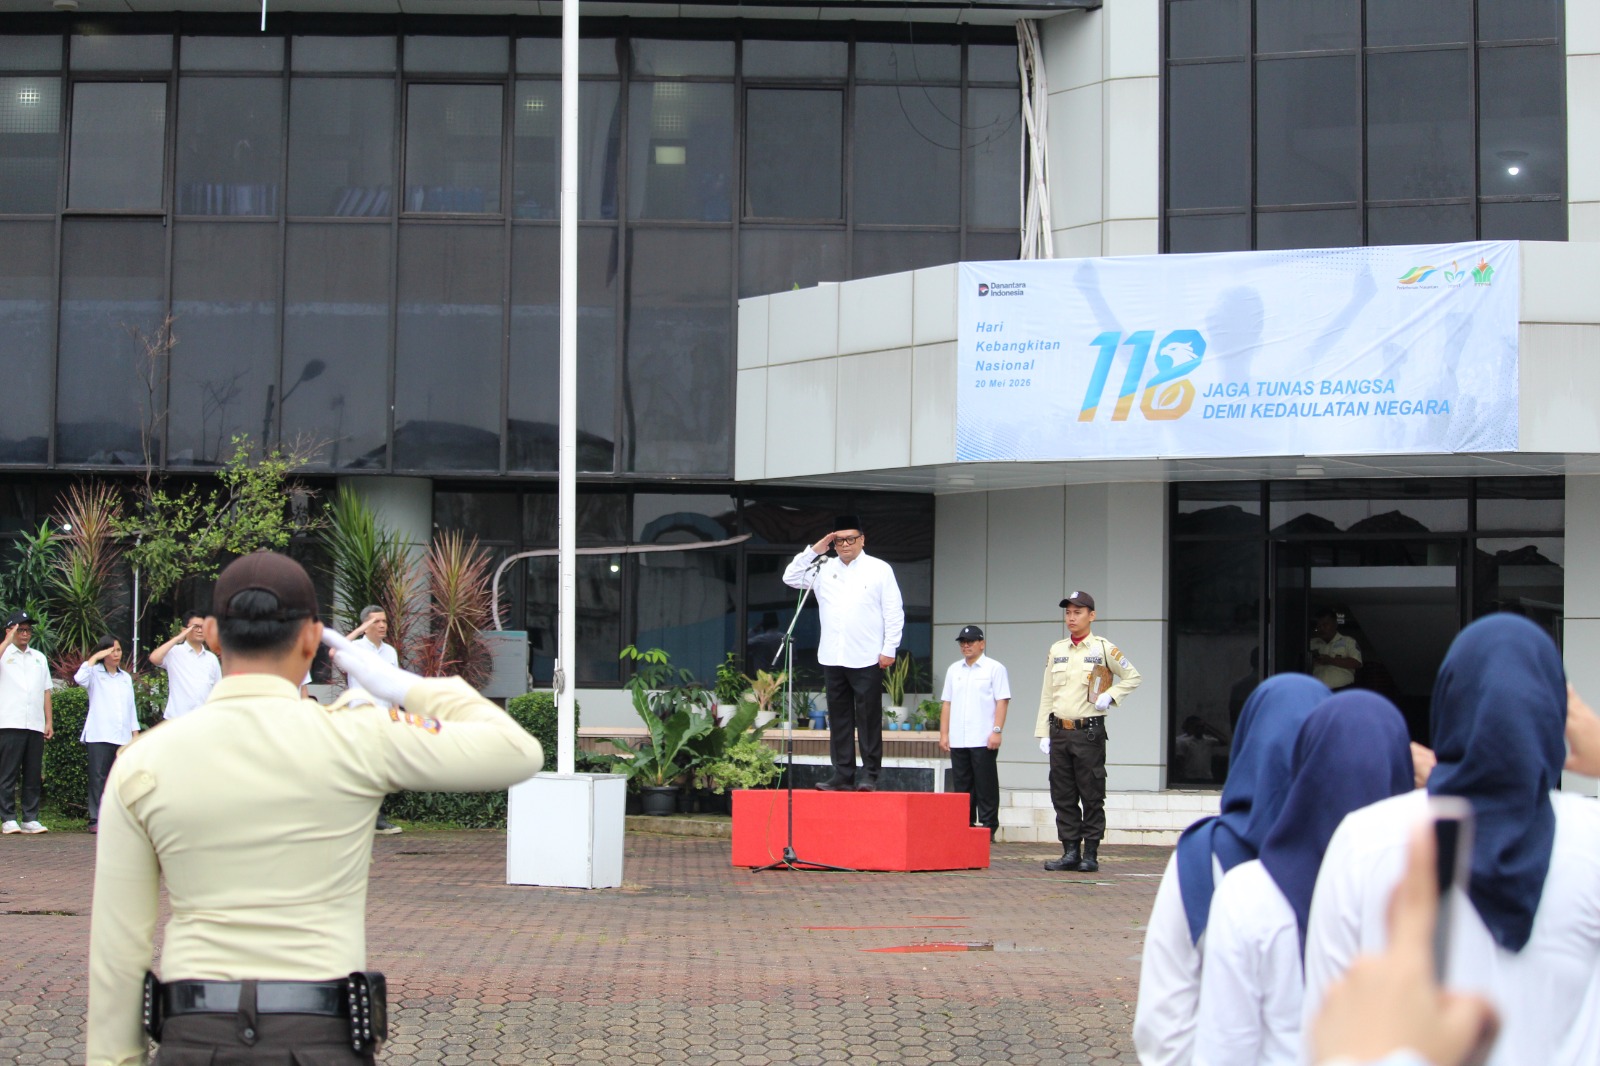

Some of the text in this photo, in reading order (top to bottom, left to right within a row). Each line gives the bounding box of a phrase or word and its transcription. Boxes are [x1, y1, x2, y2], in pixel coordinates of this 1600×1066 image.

[991, 282, 1026, 290] Danantara
[990, 289, 1024, 297] Indonesia
[976, 321, 1004, 333] Hari
[976, 340, 1061, 354] Kebangkitan
[975, 359, 1035, 371] Nasional
[1077, 329, 1207, 422] 118
[975, 378, 1031, 388] 20 Mei 2026
[1202, 378, 1396, 398] JAGA TUNAS BANGSA
[1202, 399, 1451, 420] DEMI KEDAULATAN NEGARA
